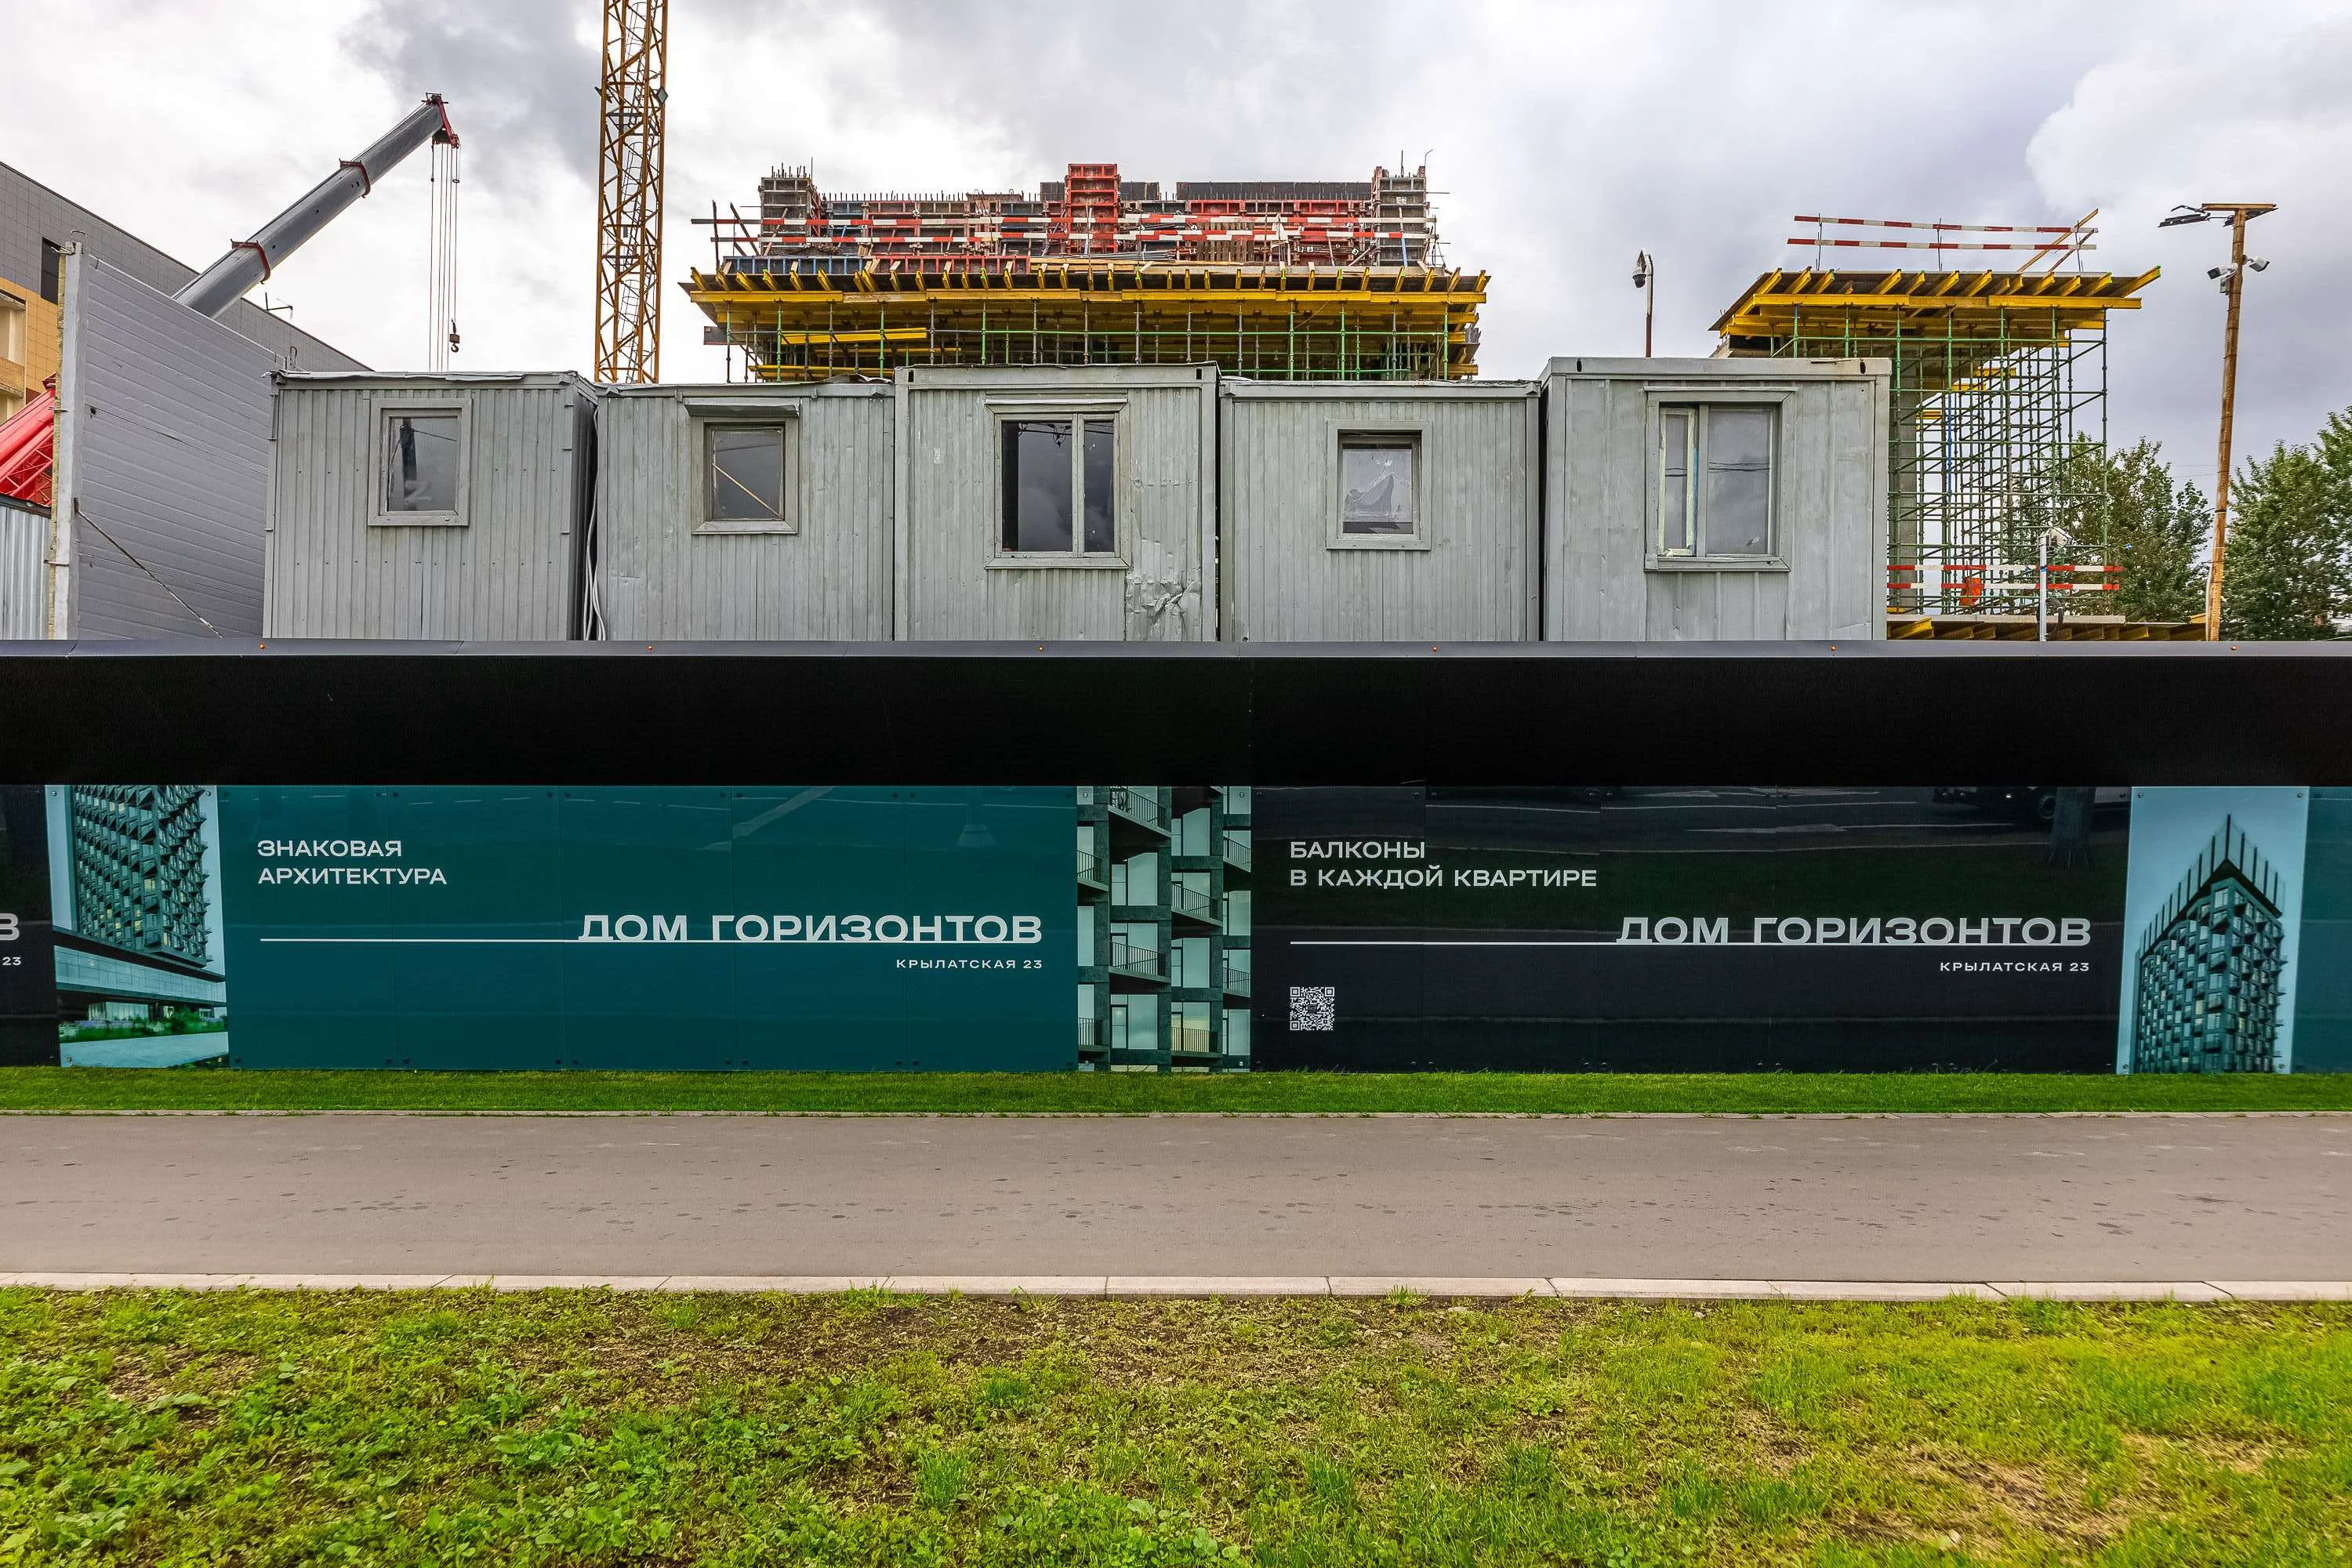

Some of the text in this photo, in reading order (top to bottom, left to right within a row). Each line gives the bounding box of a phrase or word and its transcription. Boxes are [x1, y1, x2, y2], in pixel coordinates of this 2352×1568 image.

[257, 840, 402, 857] ЗНАКОВАЯ
[1290, 841, 1425, 858] БАЛКОНЫ
[258, 867, 448, 885] АРХИТЕКТУРА
[1290, 865, 1597, 890] В КАЖДОЙ КВАРТИРЕ
[579, 914, 1042, 944] ДОМ ГОРИЗОНТОВ
[1616, 916, 2092, 946] ДОМ ГОРИЗОНТОВ
[2, 956, 22, 966] 23
[896, 959, 1043, 969] КРЫЛАТСКАЯ 23
[1940, 962, 2090, 972] КРЫЛАТСКАЯ 23
